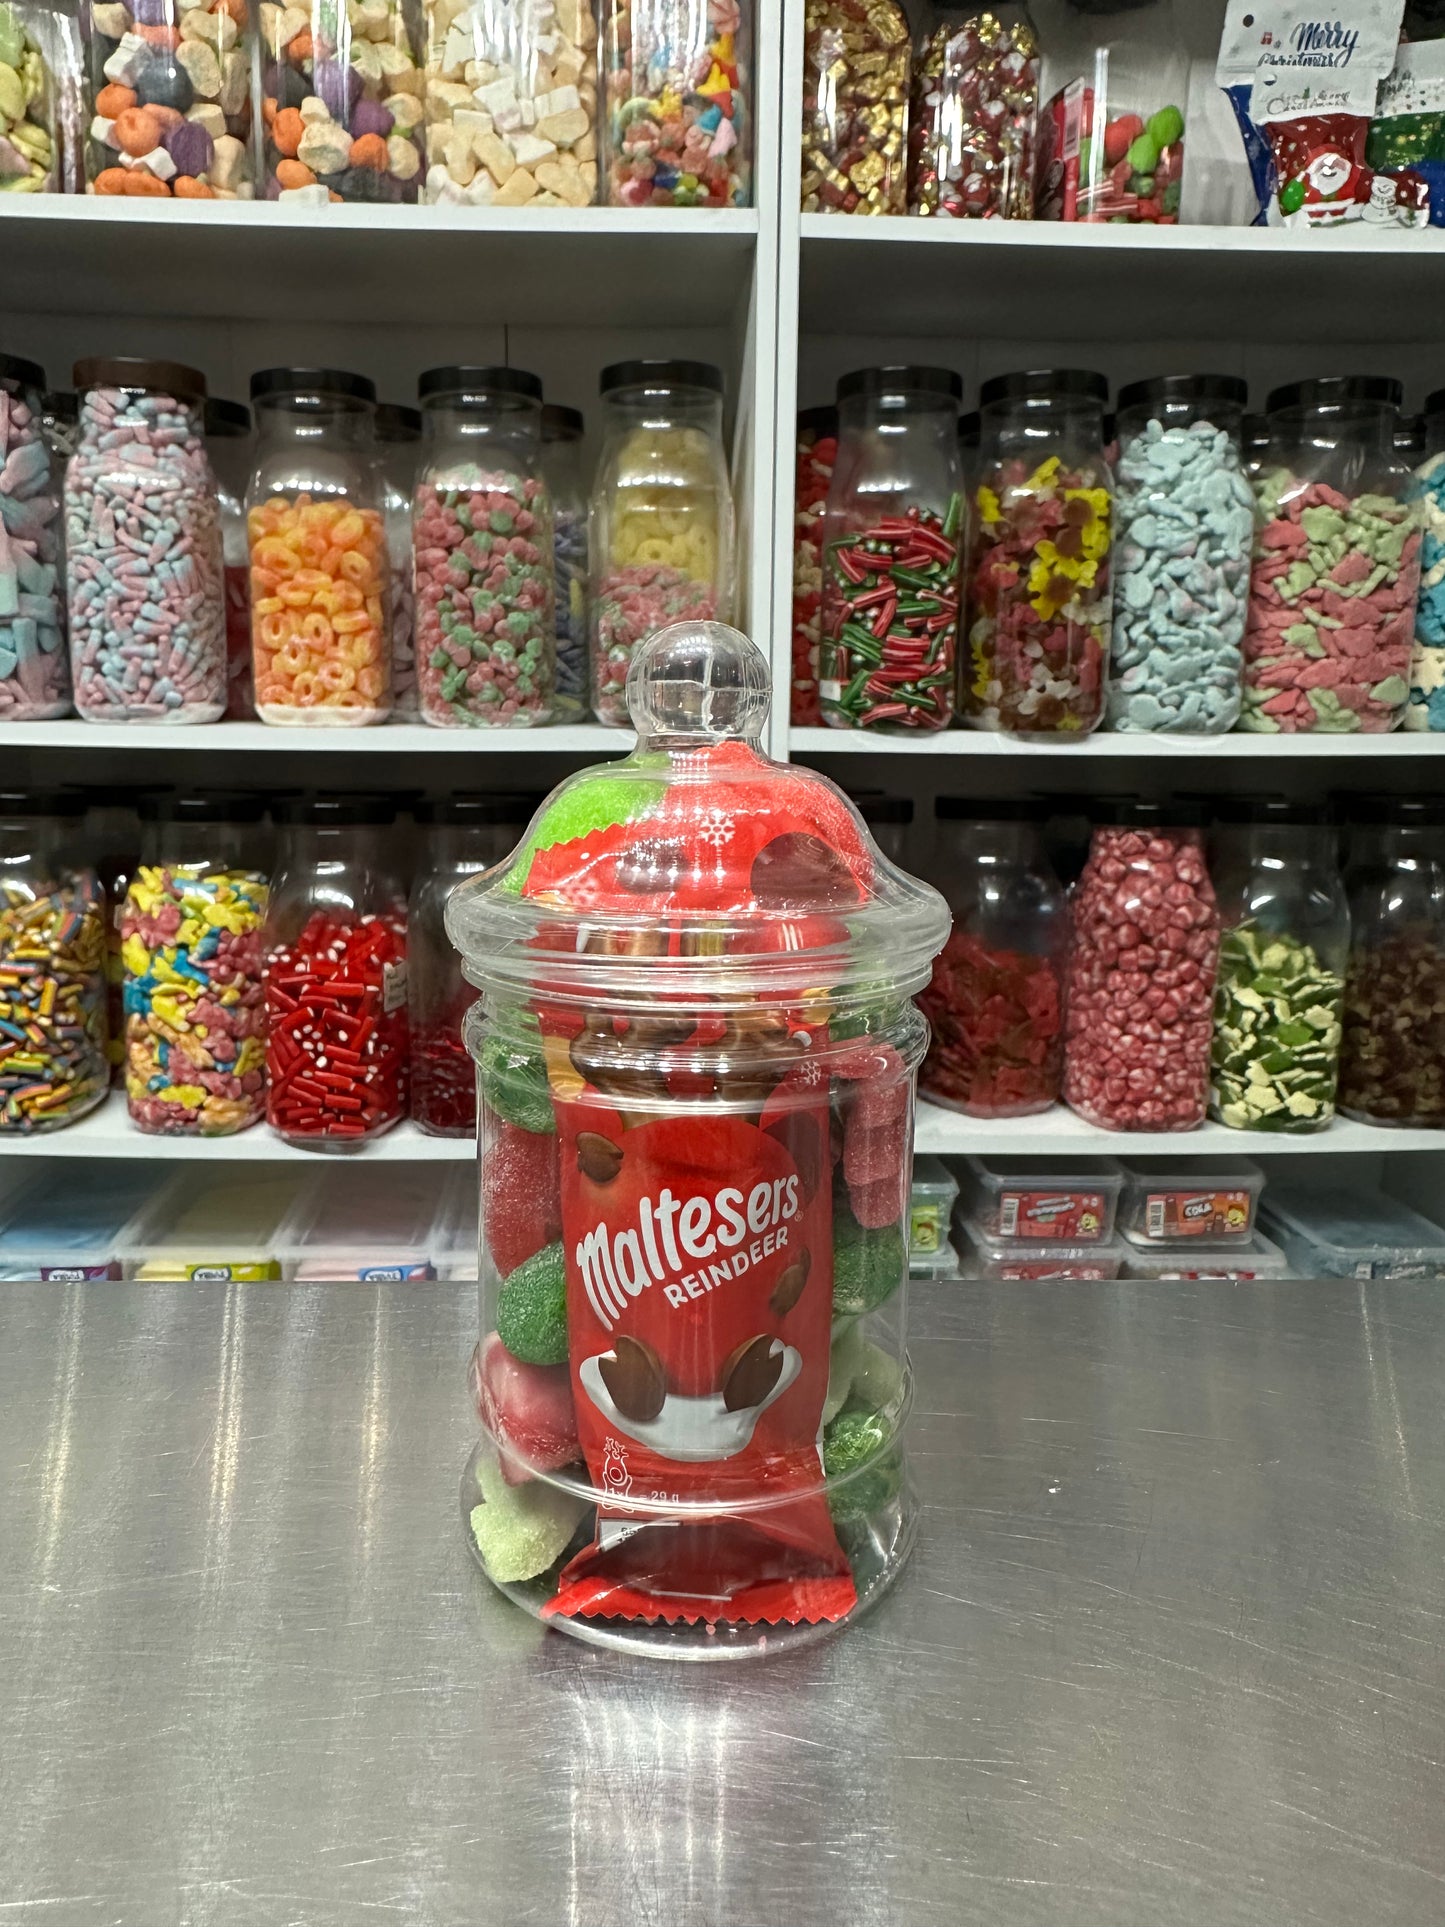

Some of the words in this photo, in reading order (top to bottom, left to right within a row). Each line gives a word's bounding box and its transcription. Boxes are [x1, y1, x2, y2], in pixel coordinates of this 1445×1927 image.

[1290, 21, 1359, 67] Merry
[576, 1174, 798, 1331] Maltesers
[664, 1226, 788, 1308] REINDEER
[651, 1490, 667, 1501] 29
